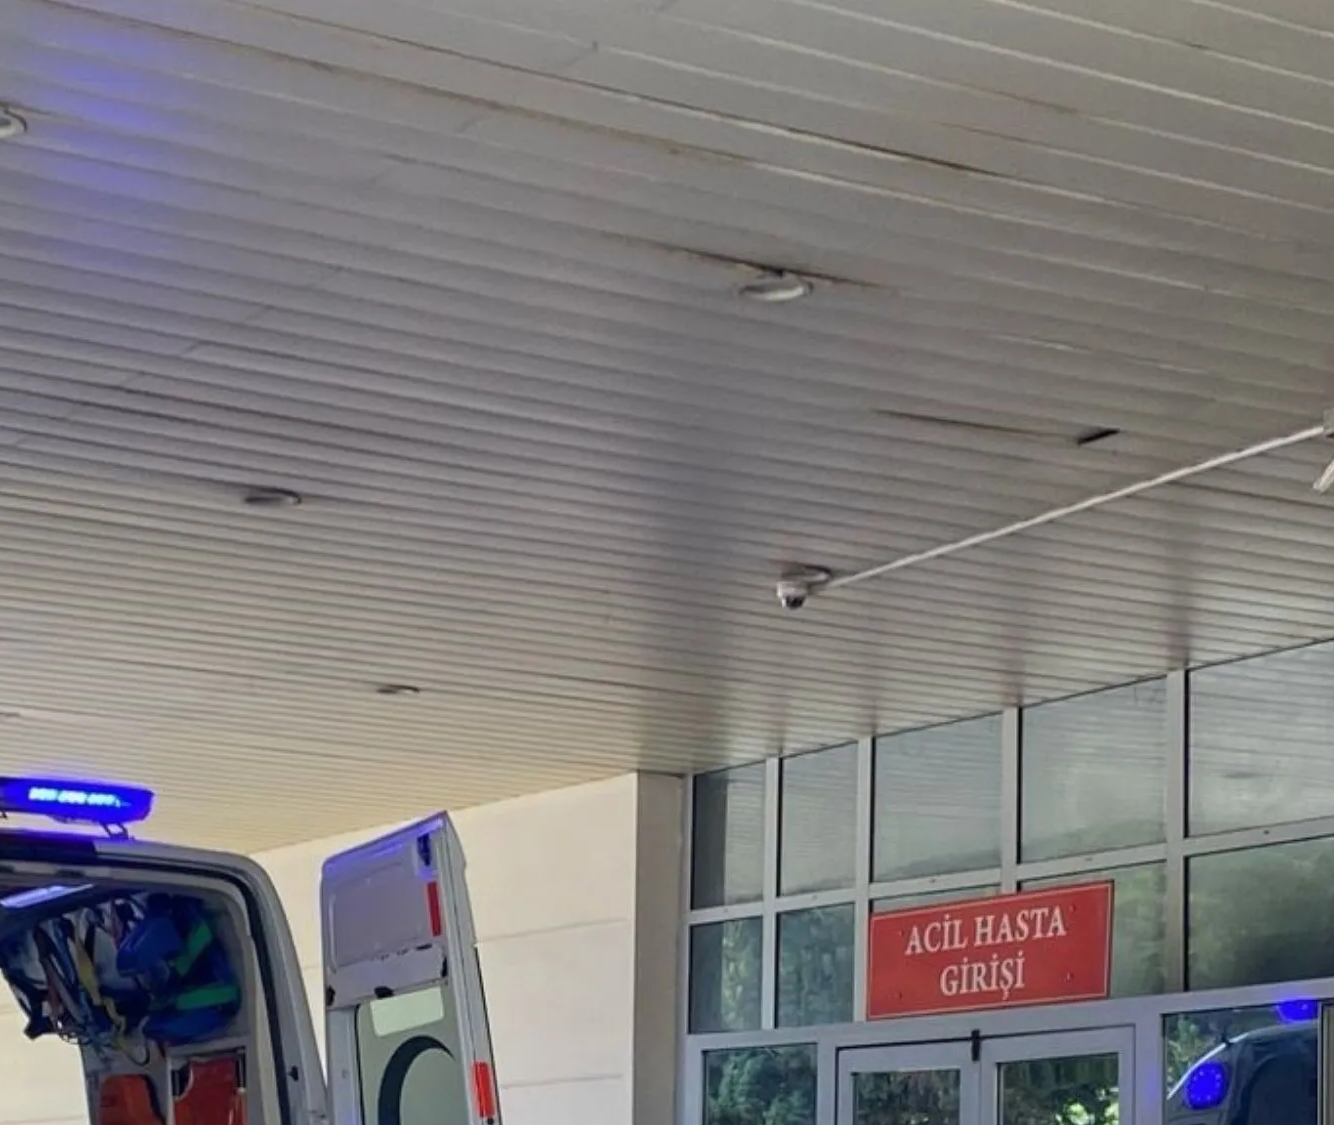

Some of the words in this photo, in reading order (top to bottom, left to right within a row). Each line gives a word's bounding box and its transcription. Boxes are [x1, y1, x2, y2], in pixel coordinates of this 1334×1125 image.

[904, 914, 968, 955] ACİL
[974, 905, 1067, 947] HASTA
[940, 950, 1026, 1000] GİRİŞİ
